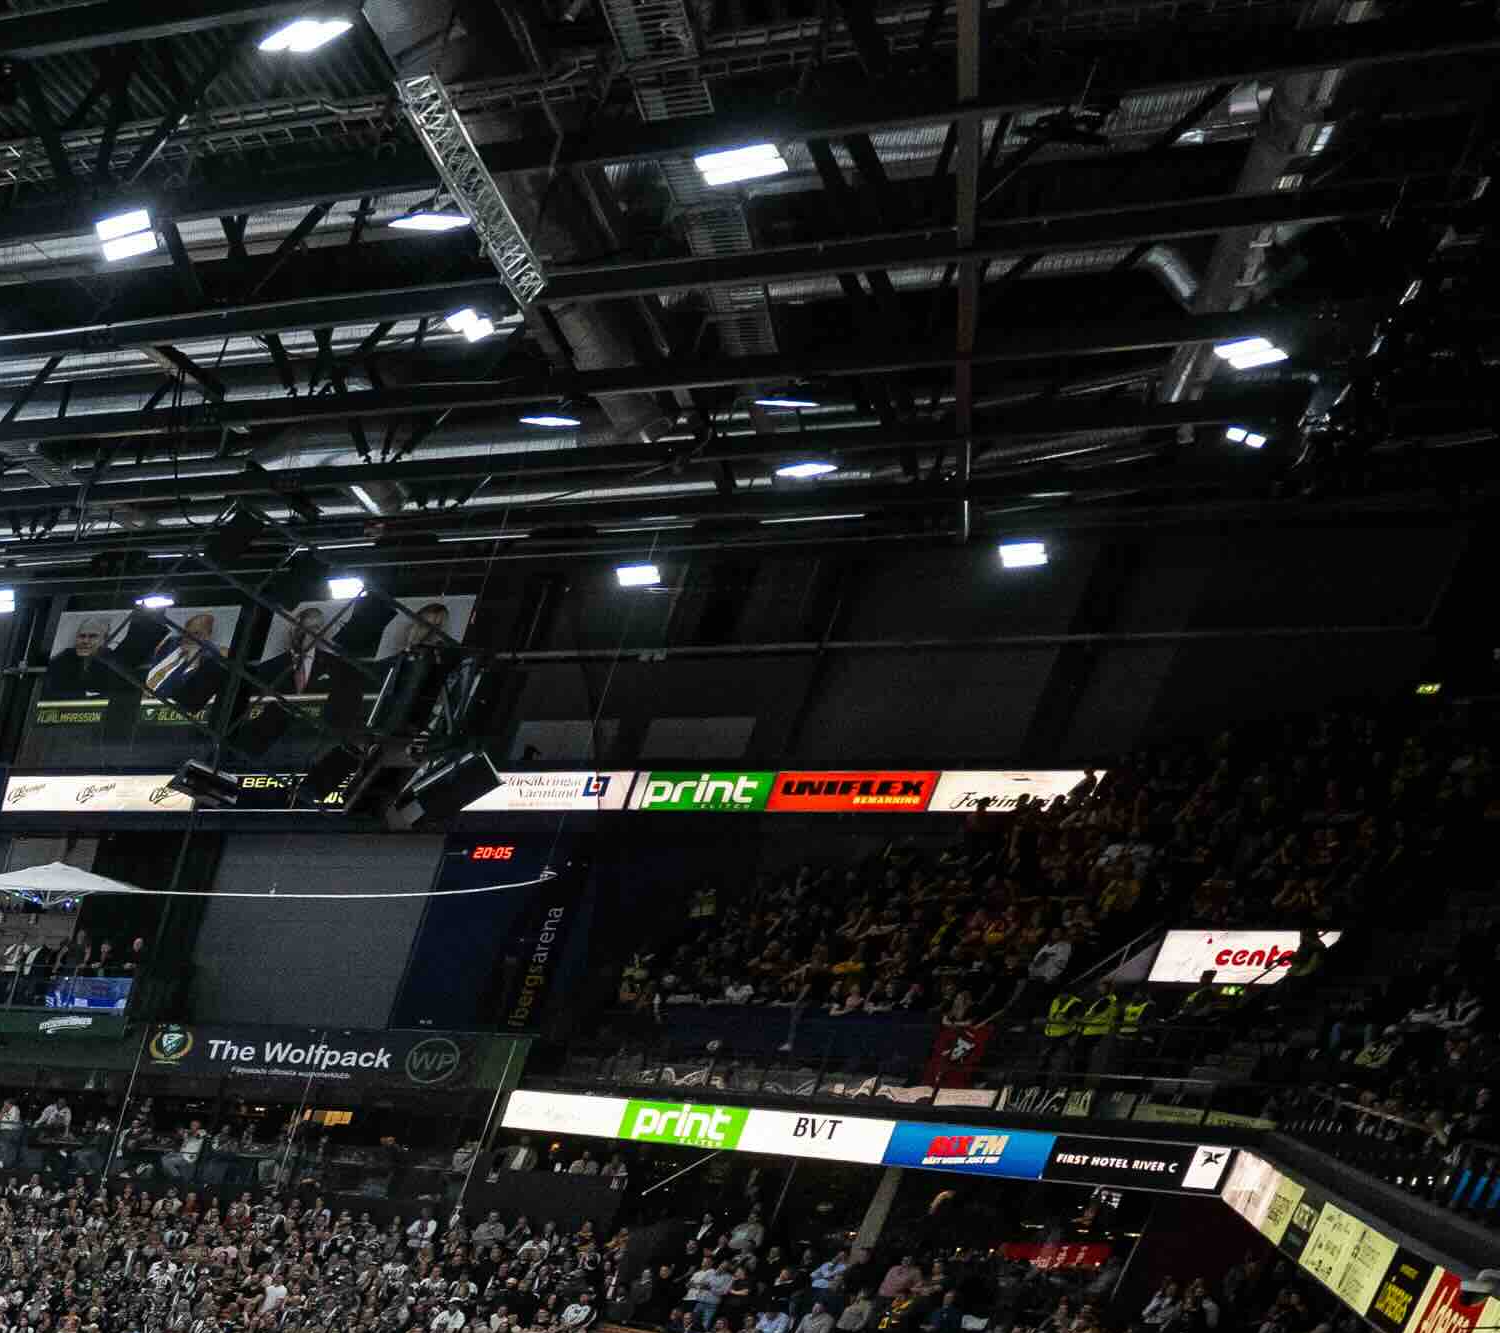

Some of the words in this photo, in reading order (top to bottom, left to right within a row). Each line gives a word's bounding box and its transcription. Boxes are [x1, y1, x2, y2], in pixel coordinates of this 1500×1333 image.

[642, 773, 759, 808] print
[780, 780, 924, 797] UNIFLEX
[472, 846, 514, 859] 20:05
[206, 1038, 258, 1065] The
[263, 1042, 392, 1070] Wolfpack
[630, 1104, 733, 1141] print
[793, 1116, 844, 1141] BVT
[1056, 1153, 1089, 1167] FIRST
[1091, 1155, 1129, 1169] HOTEL
[1132, 1158, 1165, 1172] RIVER
[1167, 1161, 1180, 1174] C
